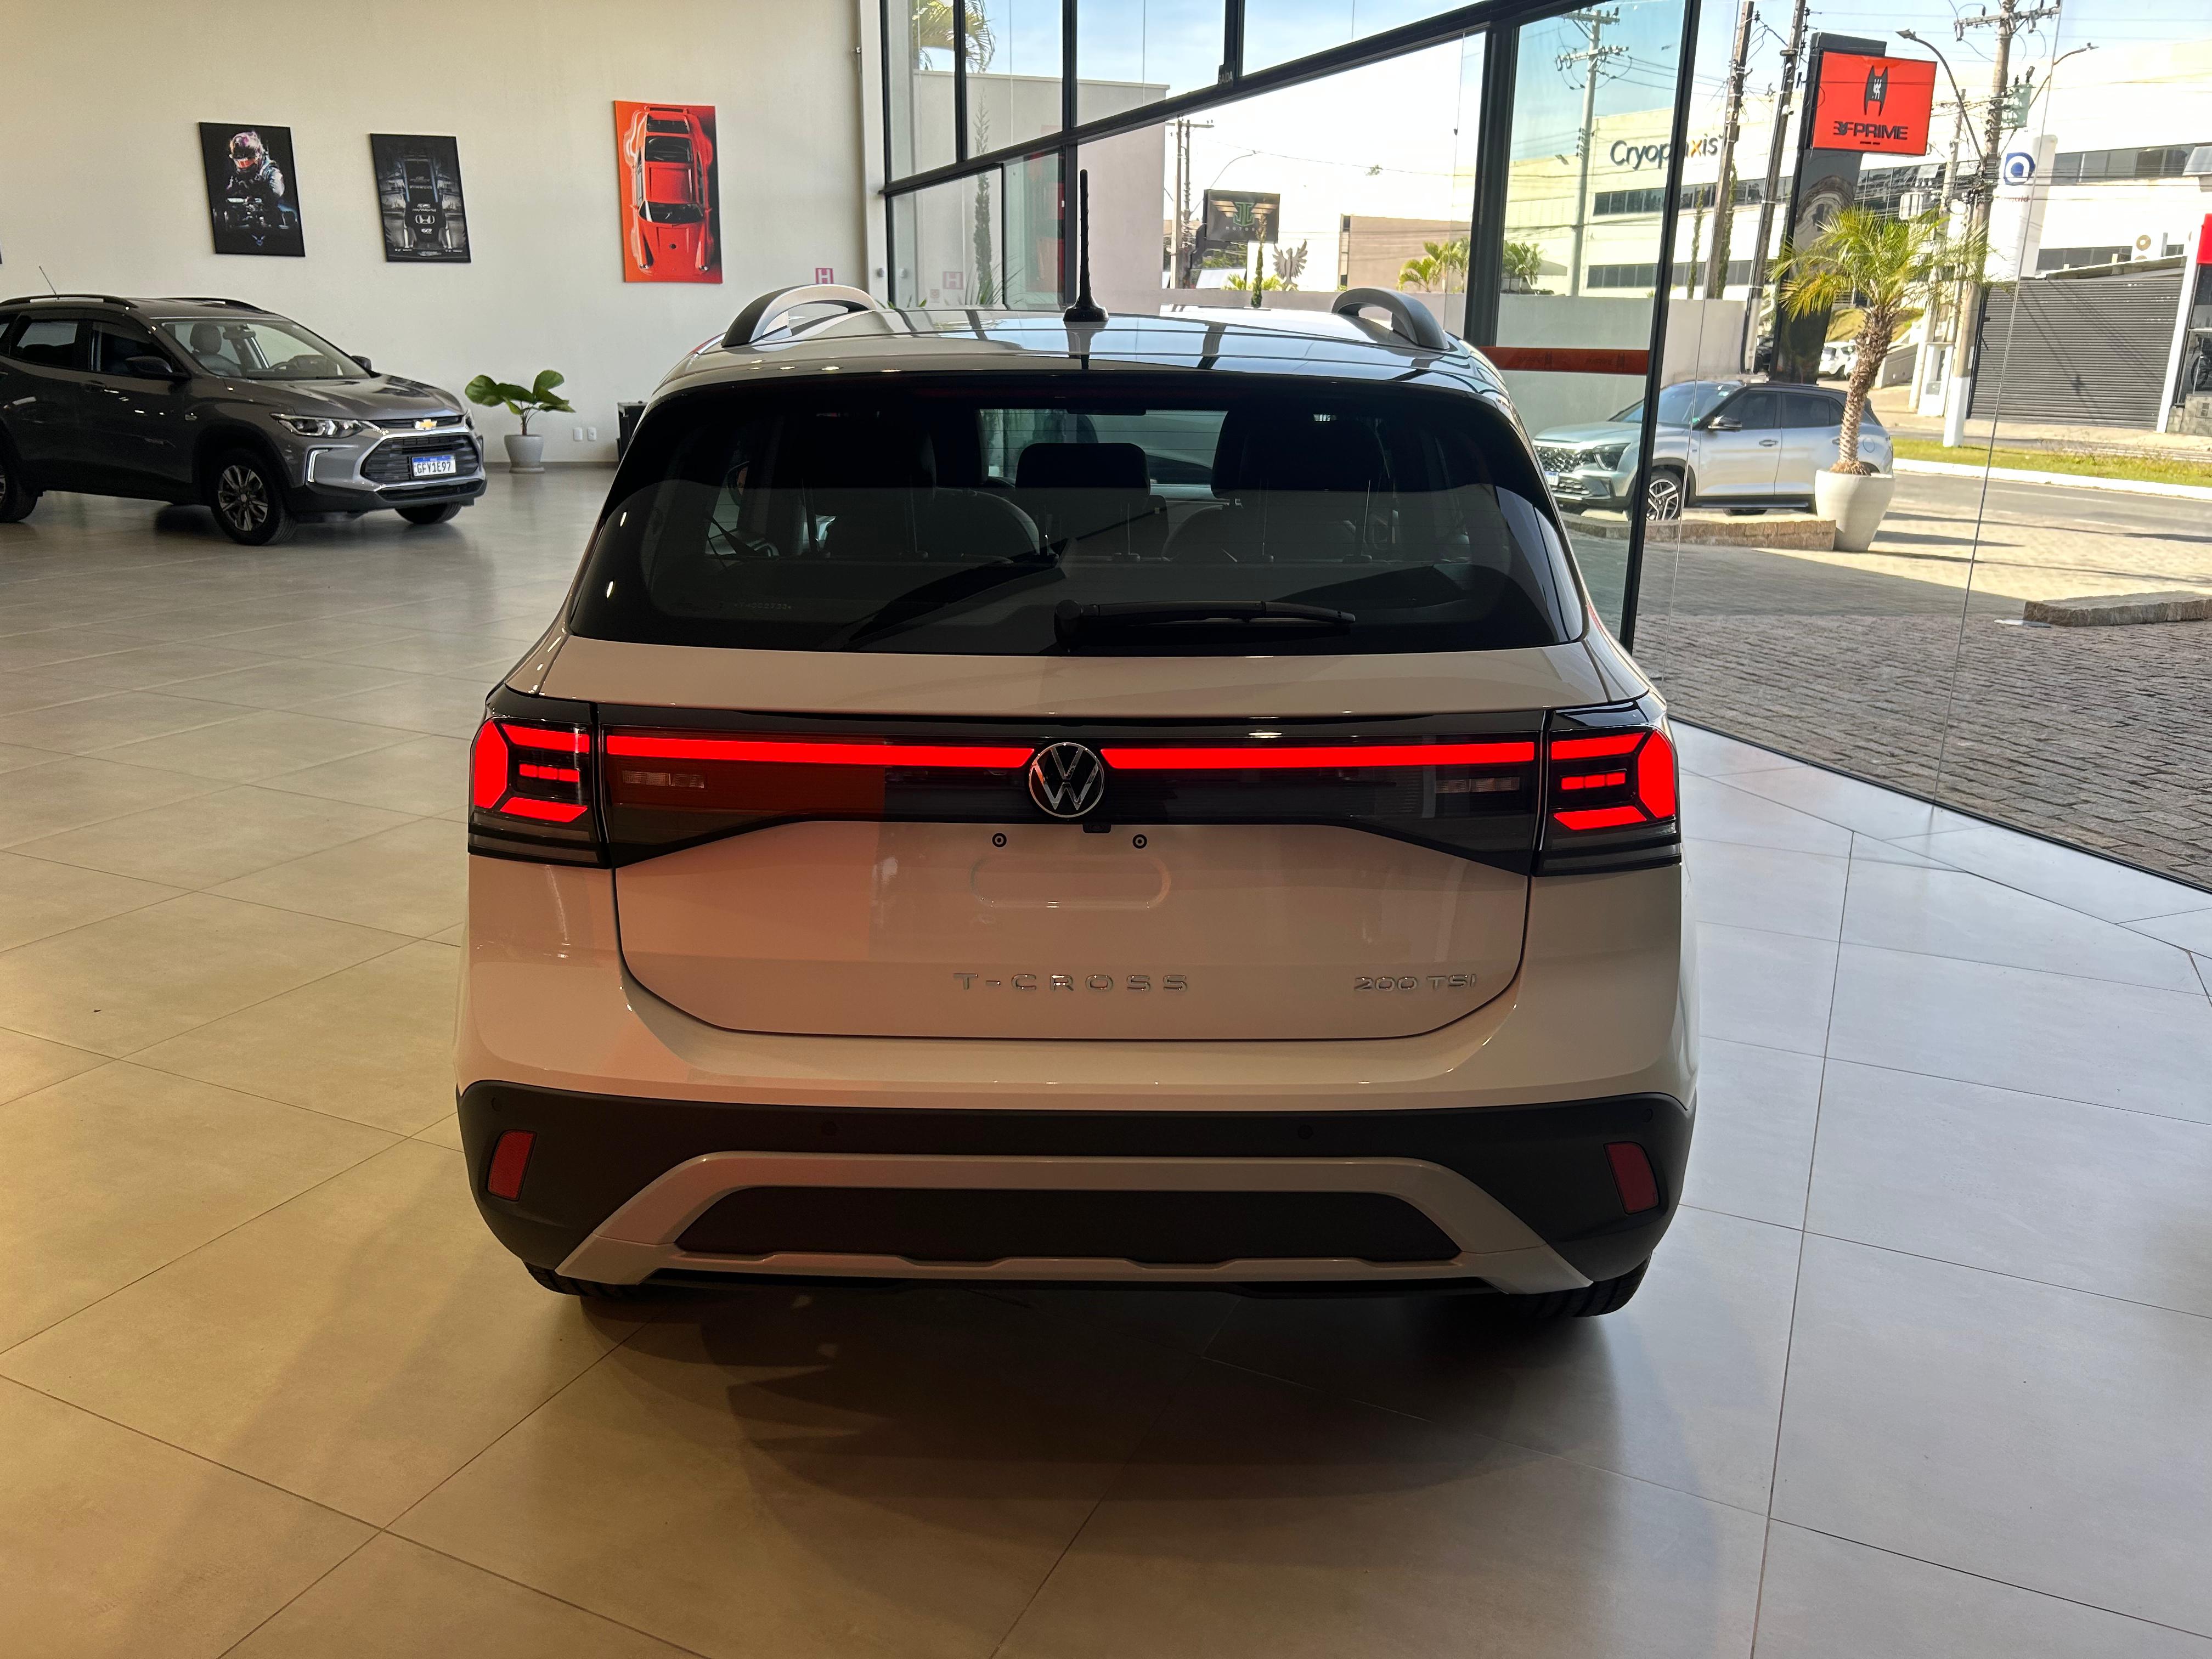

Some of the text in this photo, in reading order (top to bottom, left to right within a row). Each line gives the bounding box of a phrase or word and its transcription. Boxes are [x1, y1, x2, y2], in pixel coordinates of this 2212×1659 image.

[1610, 133, 1718, 171] Cryopxis
[417, 461, 451, 473] GFY1E97
[953, 973, 1187, 991] T-CROSS
[1354, 974, 1477, 991] 200 TSI
